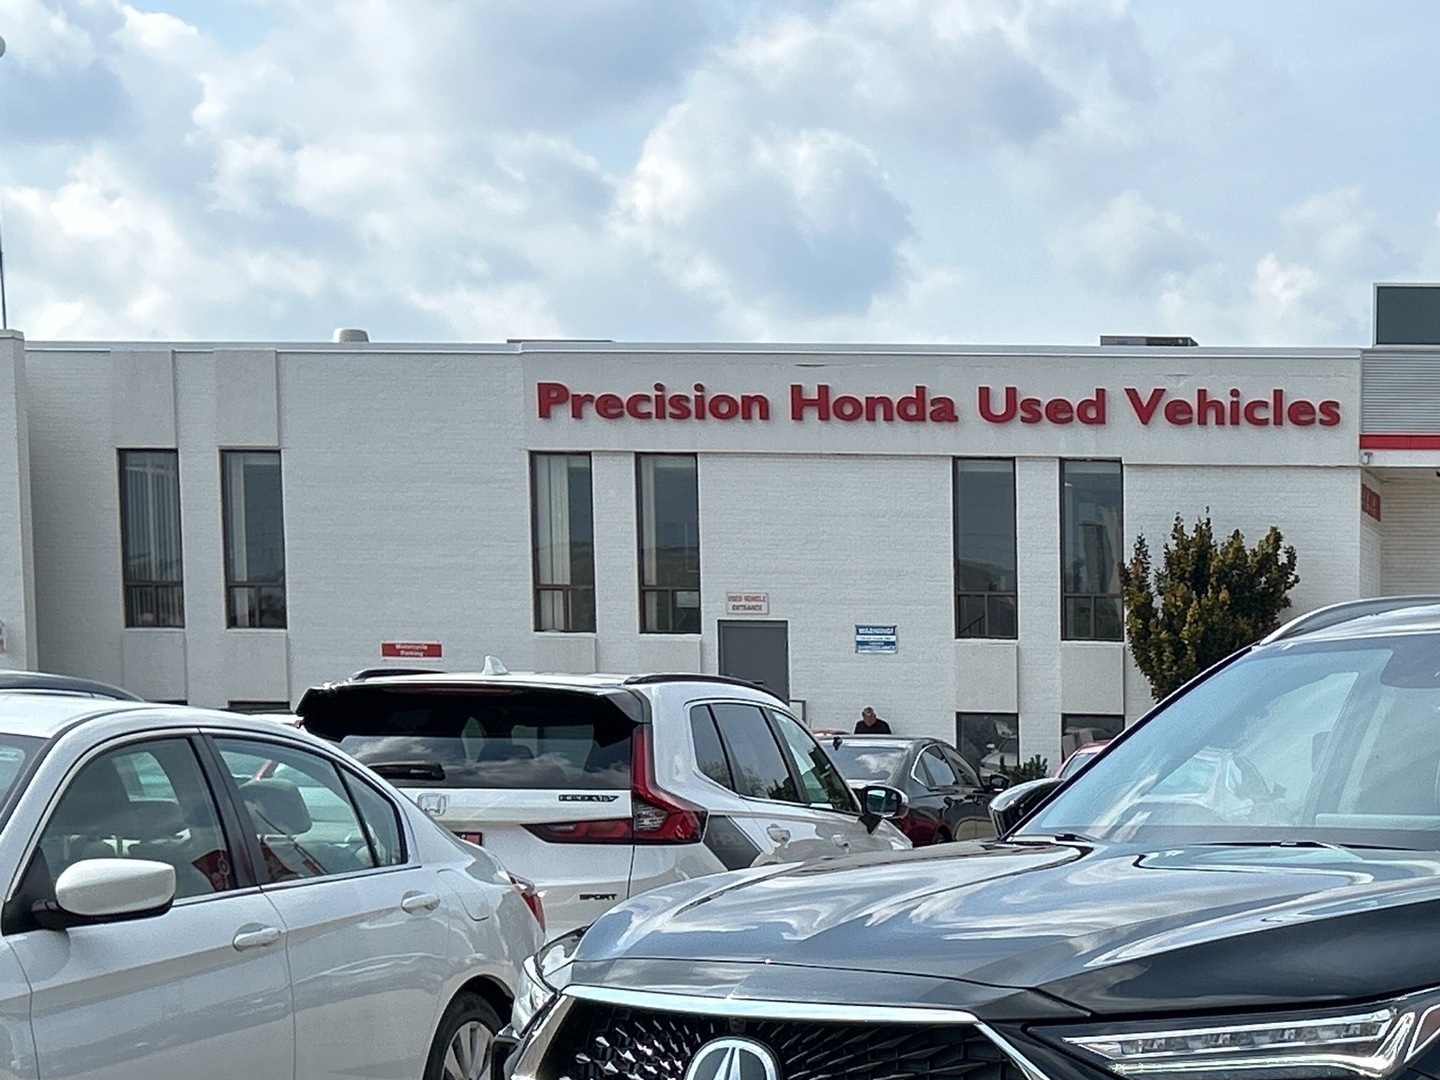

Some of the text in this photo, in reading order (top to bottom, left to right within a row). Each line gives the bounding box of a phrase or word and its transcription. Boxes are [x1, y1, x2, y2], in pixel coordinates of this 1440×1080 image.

[537, 383, 1341, 427] Precision Honda Used Vehicles
[579, 893, 618, 901] SPORT
